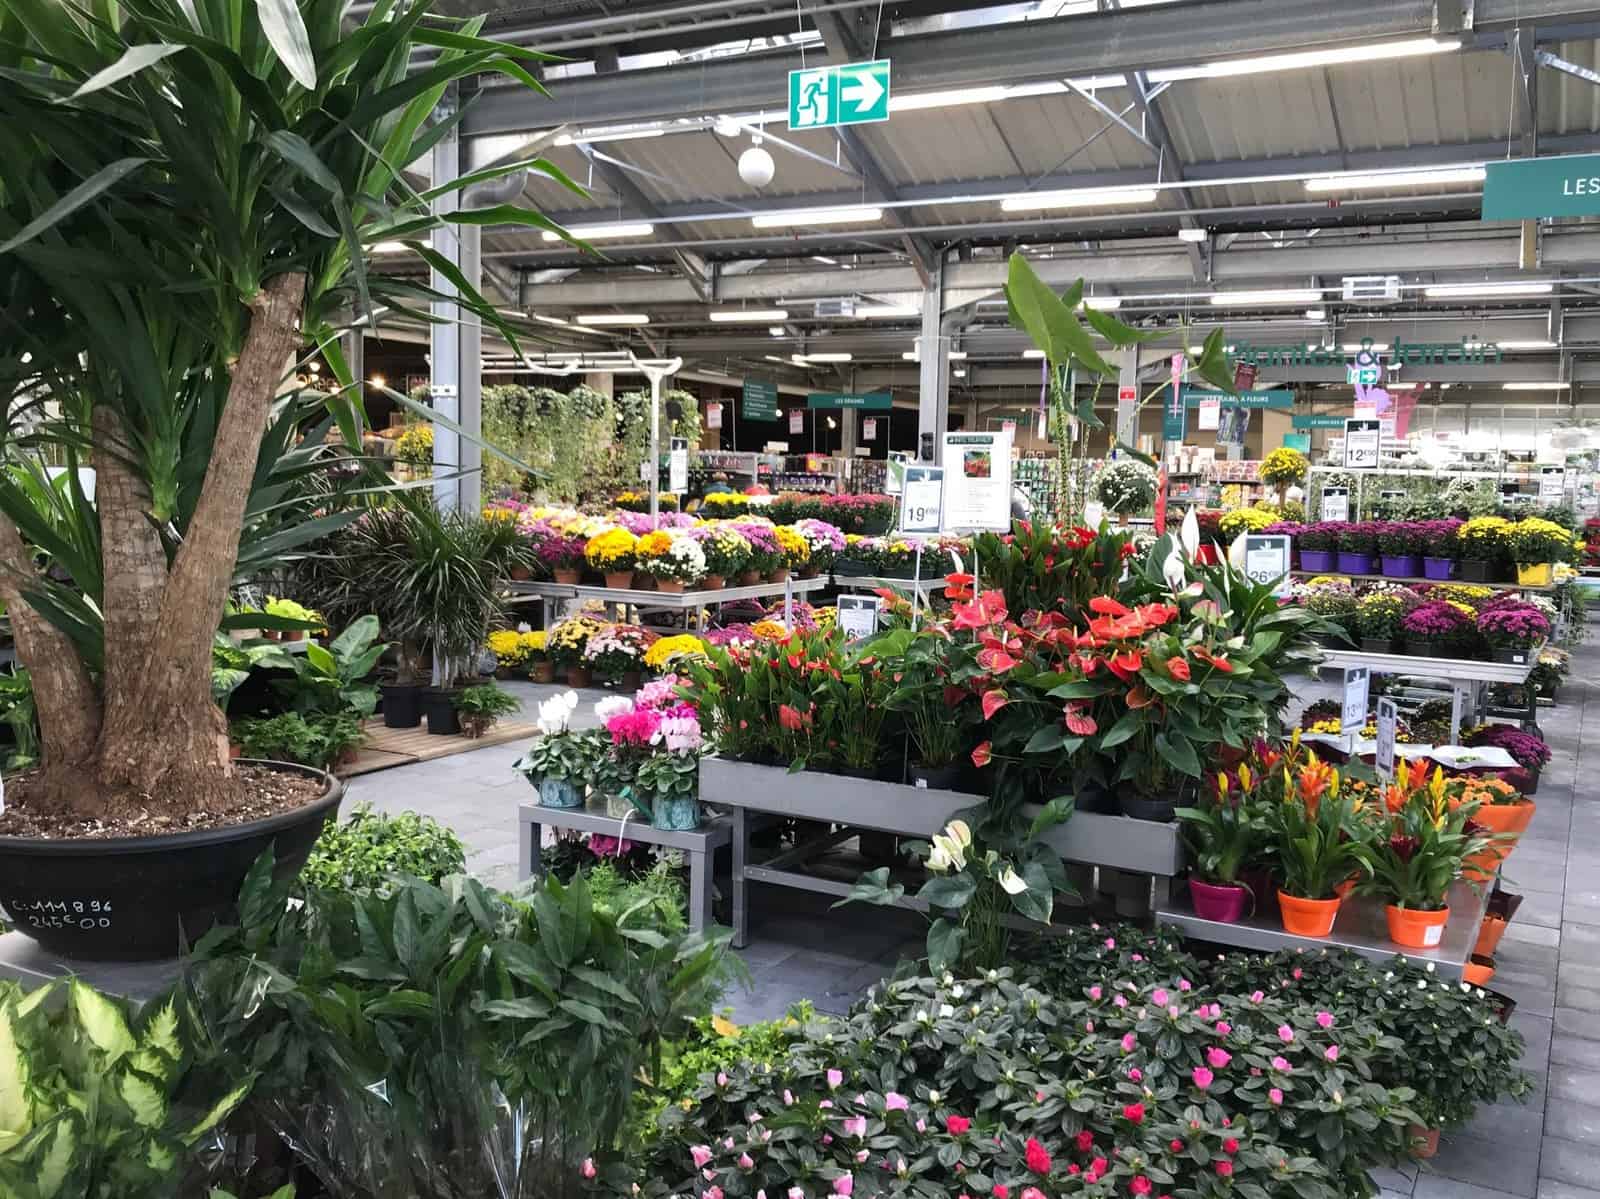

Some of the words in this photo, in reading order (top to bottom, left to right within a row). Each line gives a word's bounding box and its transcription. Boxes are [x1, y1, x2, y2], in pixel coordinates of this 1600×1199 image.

[1563, 177, 1600, 196] LES
[1357, 337, 1380, 367] &
[1387, 334, 1503, 367] Jardin
